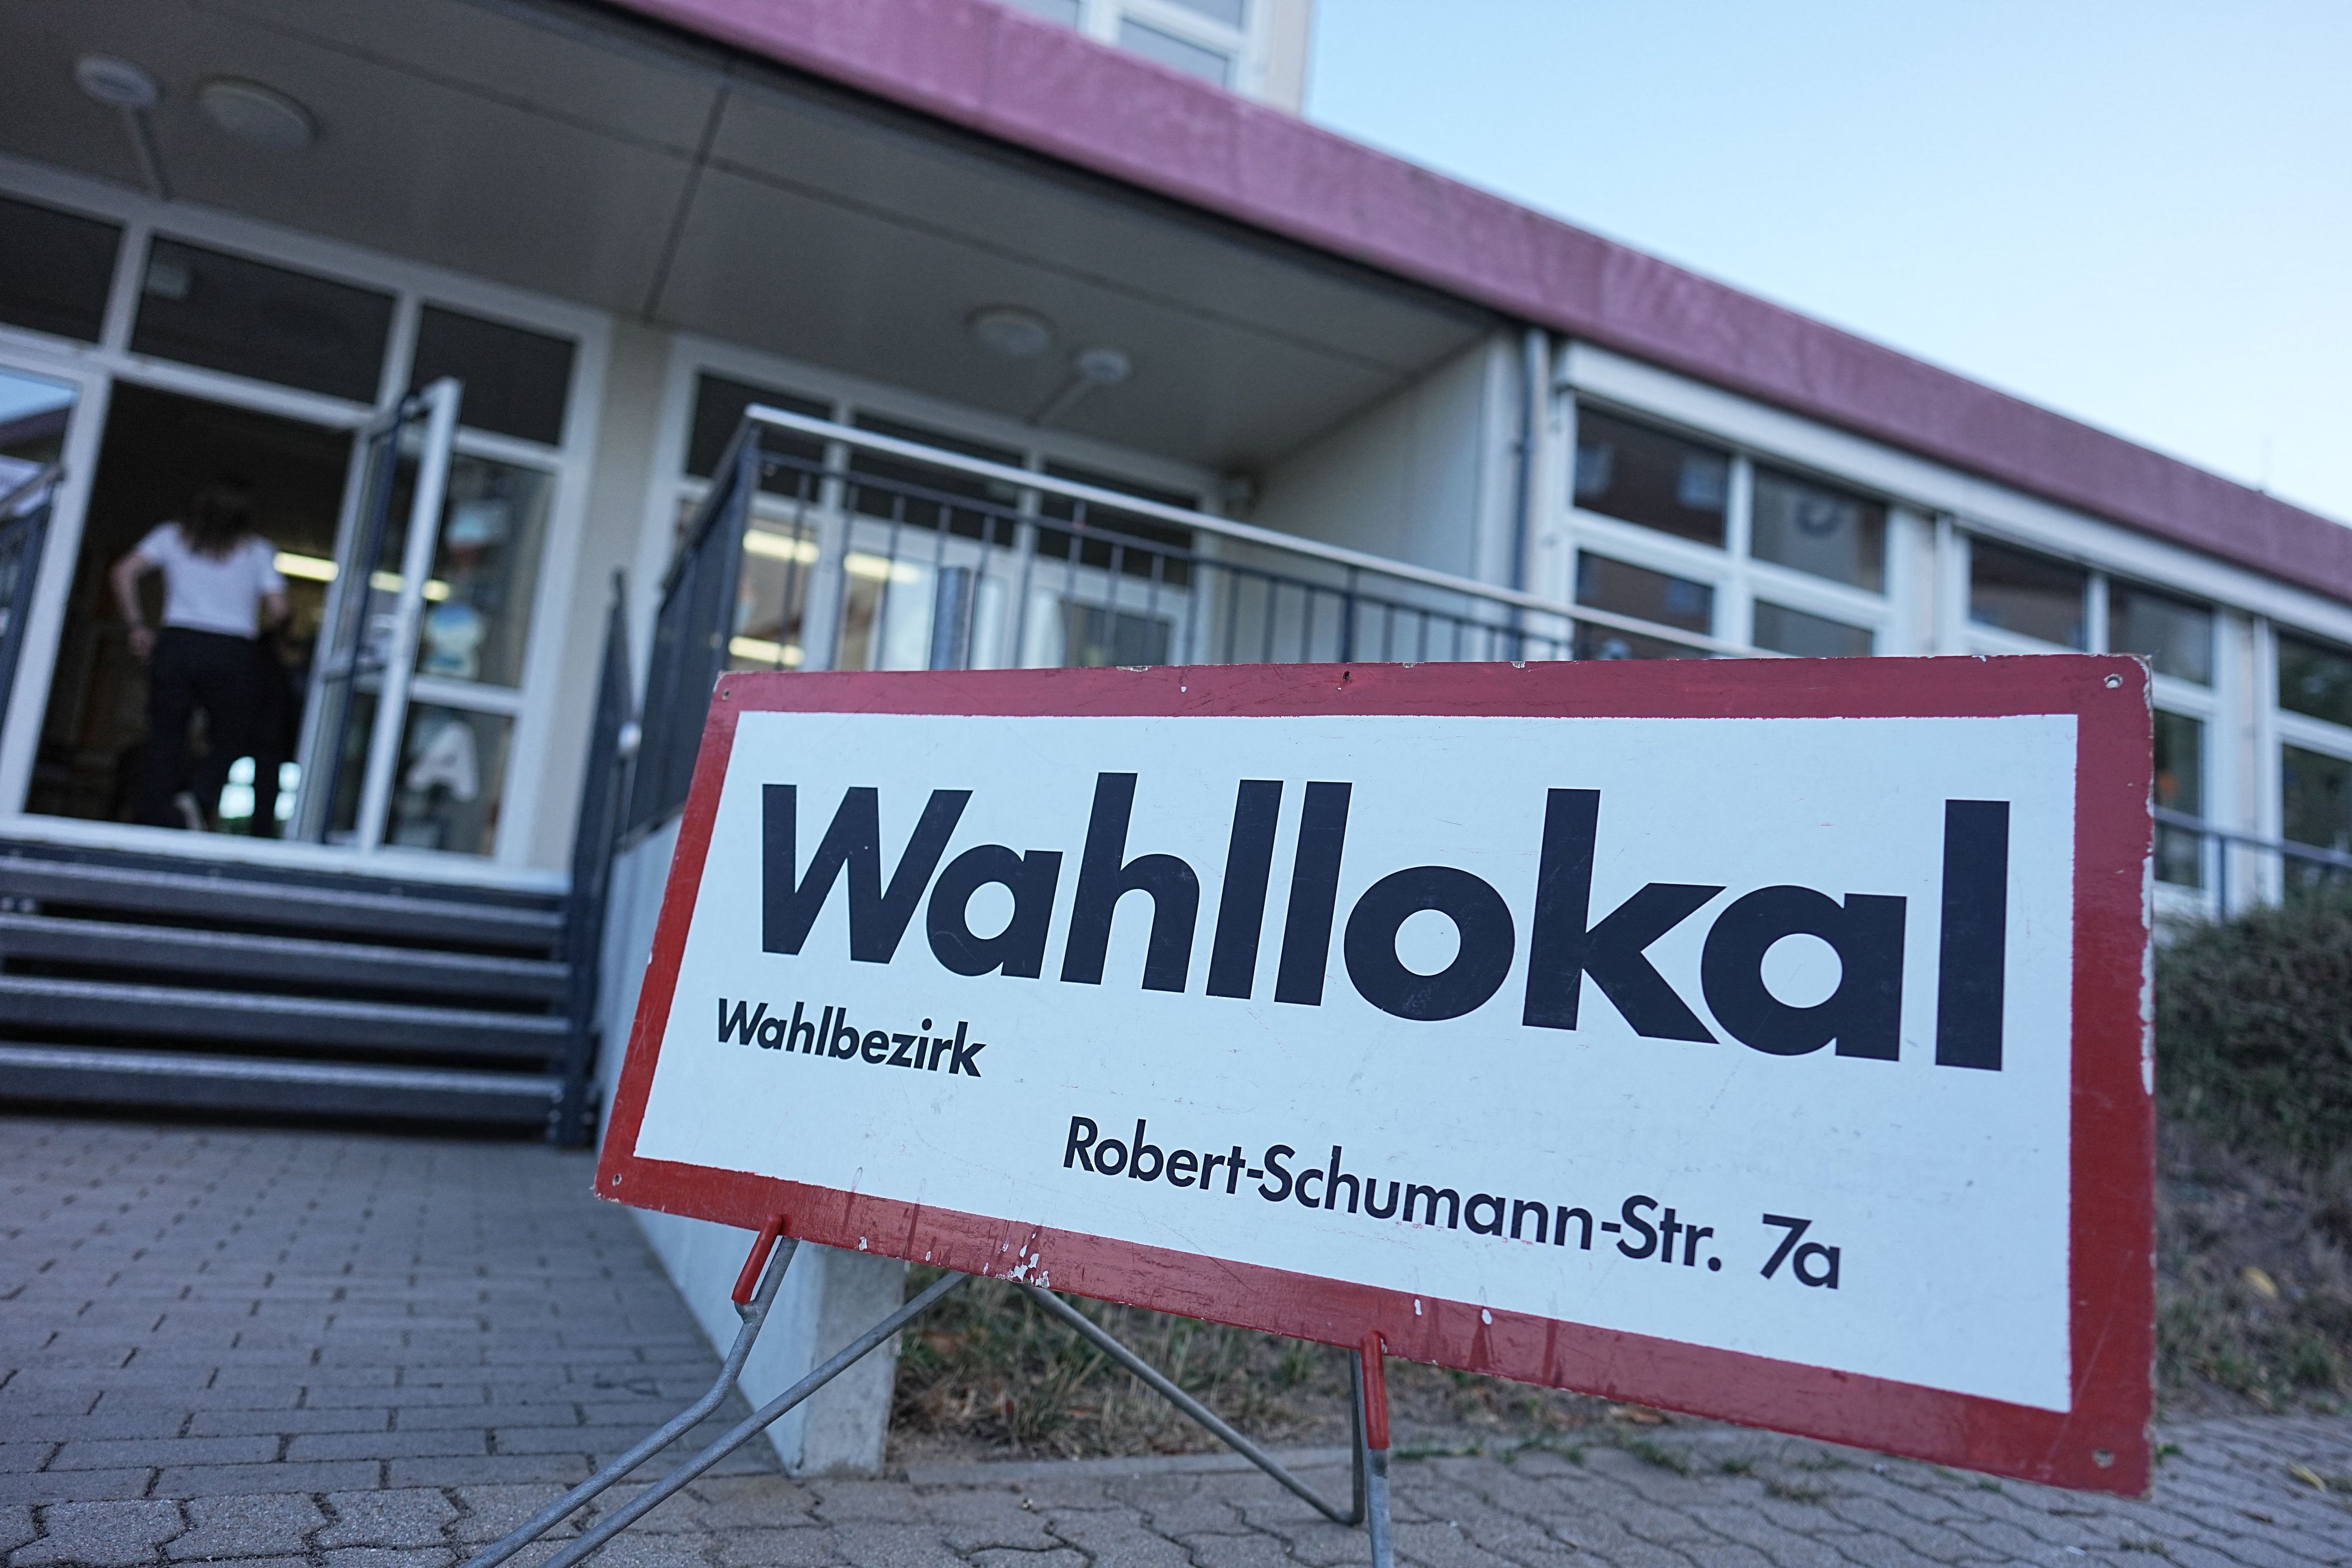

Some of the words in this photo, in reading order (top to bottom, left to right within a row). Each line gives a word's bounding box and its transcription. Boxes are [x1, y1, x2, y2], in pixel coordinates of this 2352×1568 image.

[761, 771, 2011, 1072] Wahllokal
[717, 997, 988, 1078] Wahlbezirk
[1063, 1115, 1722, 1272] Robert-Schumann-Str.
[1759, 1212, 1841, 1290] 7a
